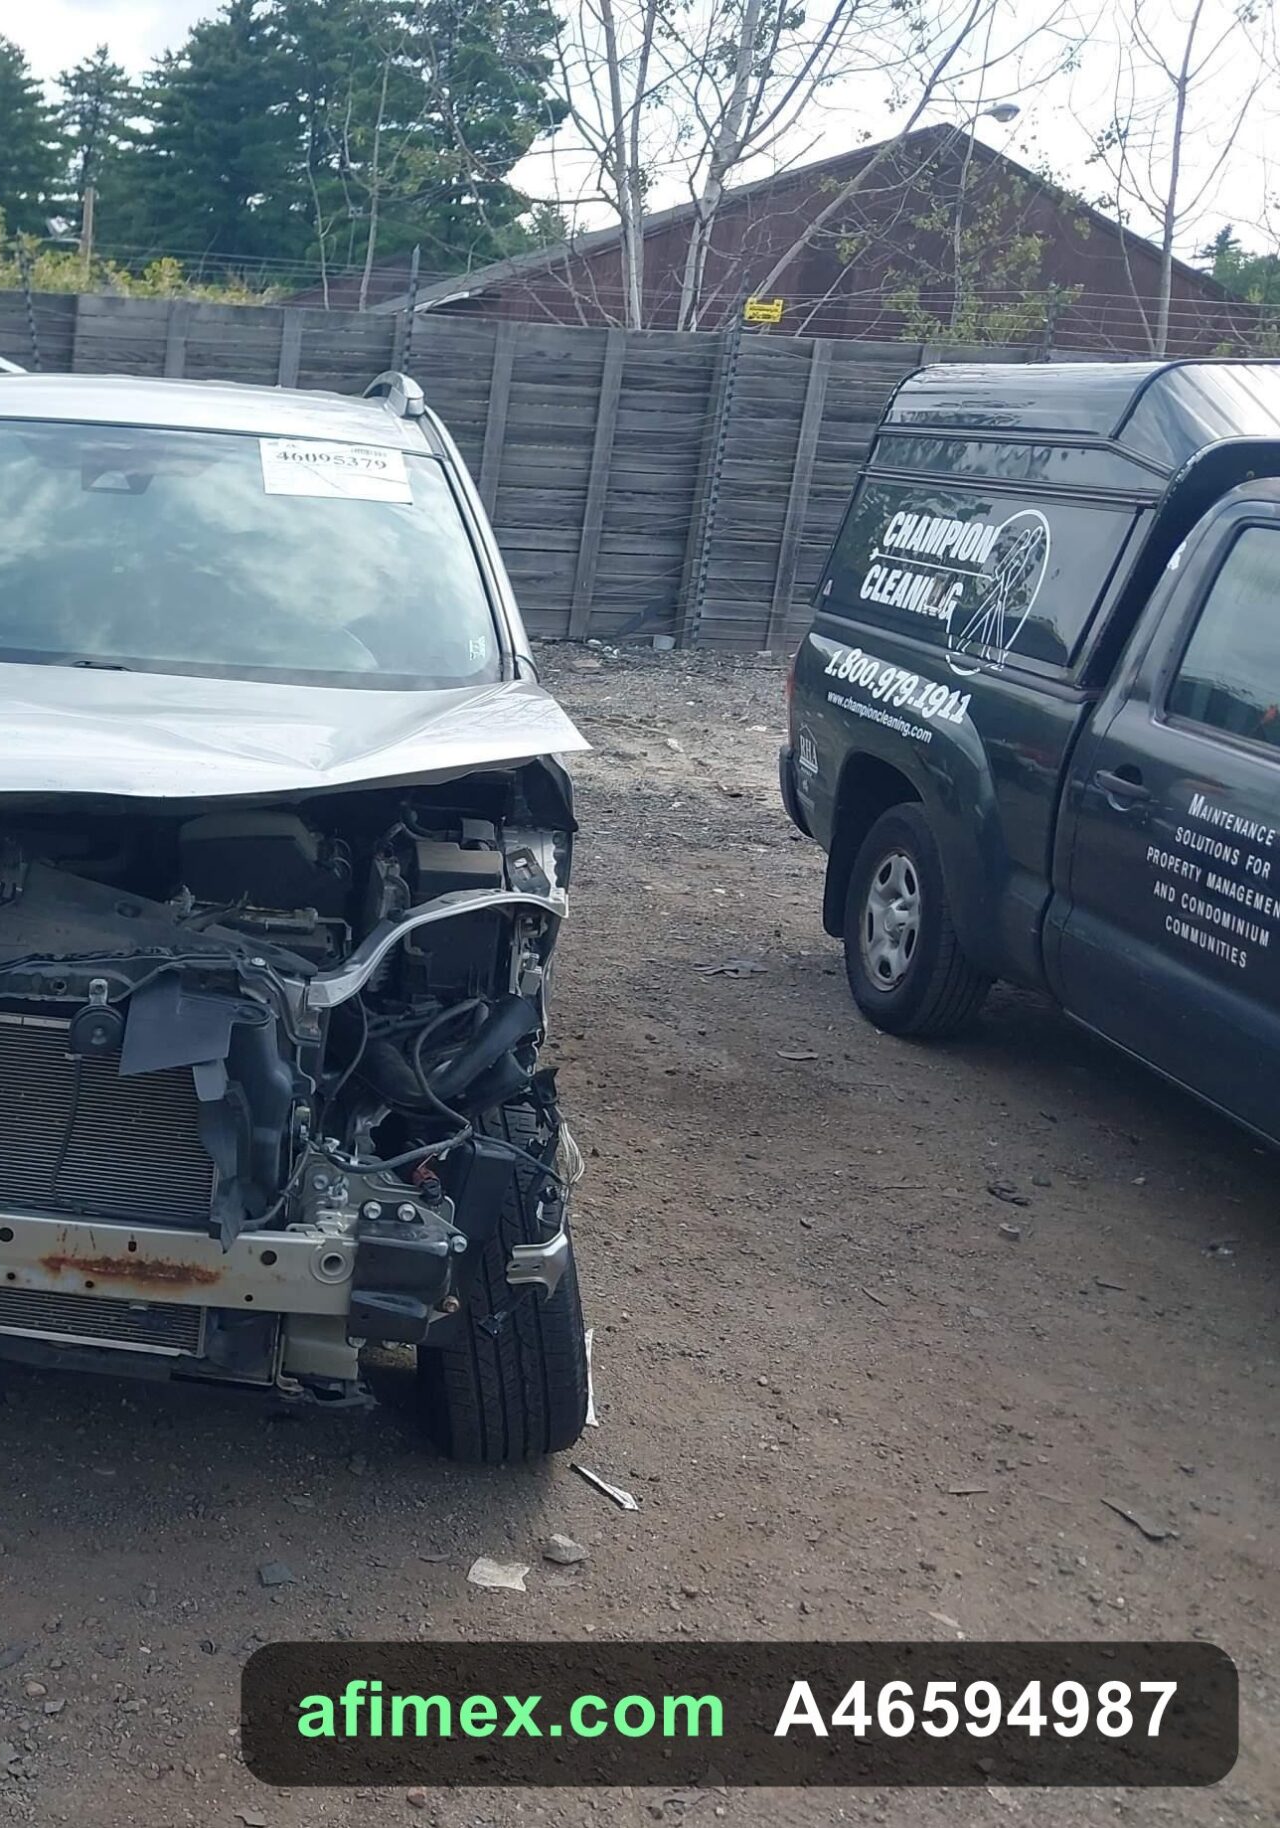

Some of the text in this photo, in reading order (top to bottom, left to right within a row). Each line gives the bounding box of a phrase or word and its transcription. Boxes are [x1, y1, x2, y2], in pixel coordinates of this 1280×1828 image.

[883, 511, 1001, 563] CHAMPION
[824, 648, 971, 724] 1.800.979.1911
[827, 692, 933, 743] www.championcleaning.com
[1175, 827, 1271, 880] SOLUTIONS FOR
[1146, 846, 1280, 919] PROPERTY MANAGEMEN
[1153, 881, 1270, 947] AND CONDOMINIUM
[1165, 915, 1247, 968] COMMUNITIES
